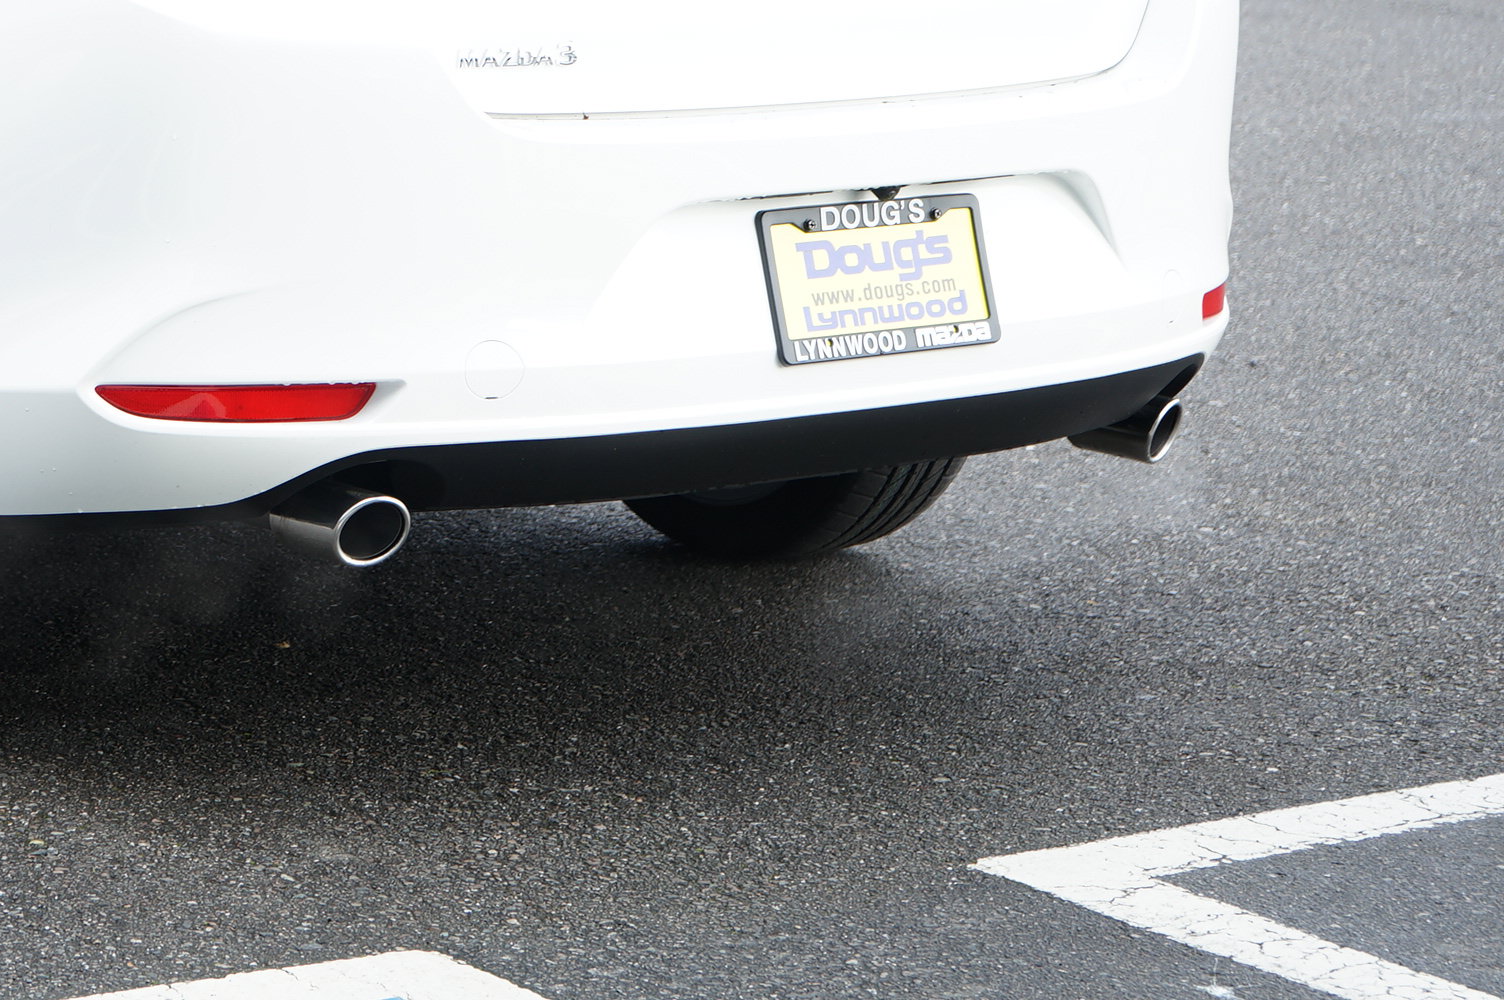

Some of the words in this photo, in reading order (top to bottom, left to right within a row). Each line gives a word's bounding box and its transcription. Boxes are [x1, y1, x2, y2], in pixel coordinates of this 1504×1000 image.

[820, 199, 925, 231] DOUG'S
[811, 276, 957, 306] www.dougs.com
[803, 290, 968, 332] Lynnwood
[794, 330, 907, 361] LYNNWOOD
